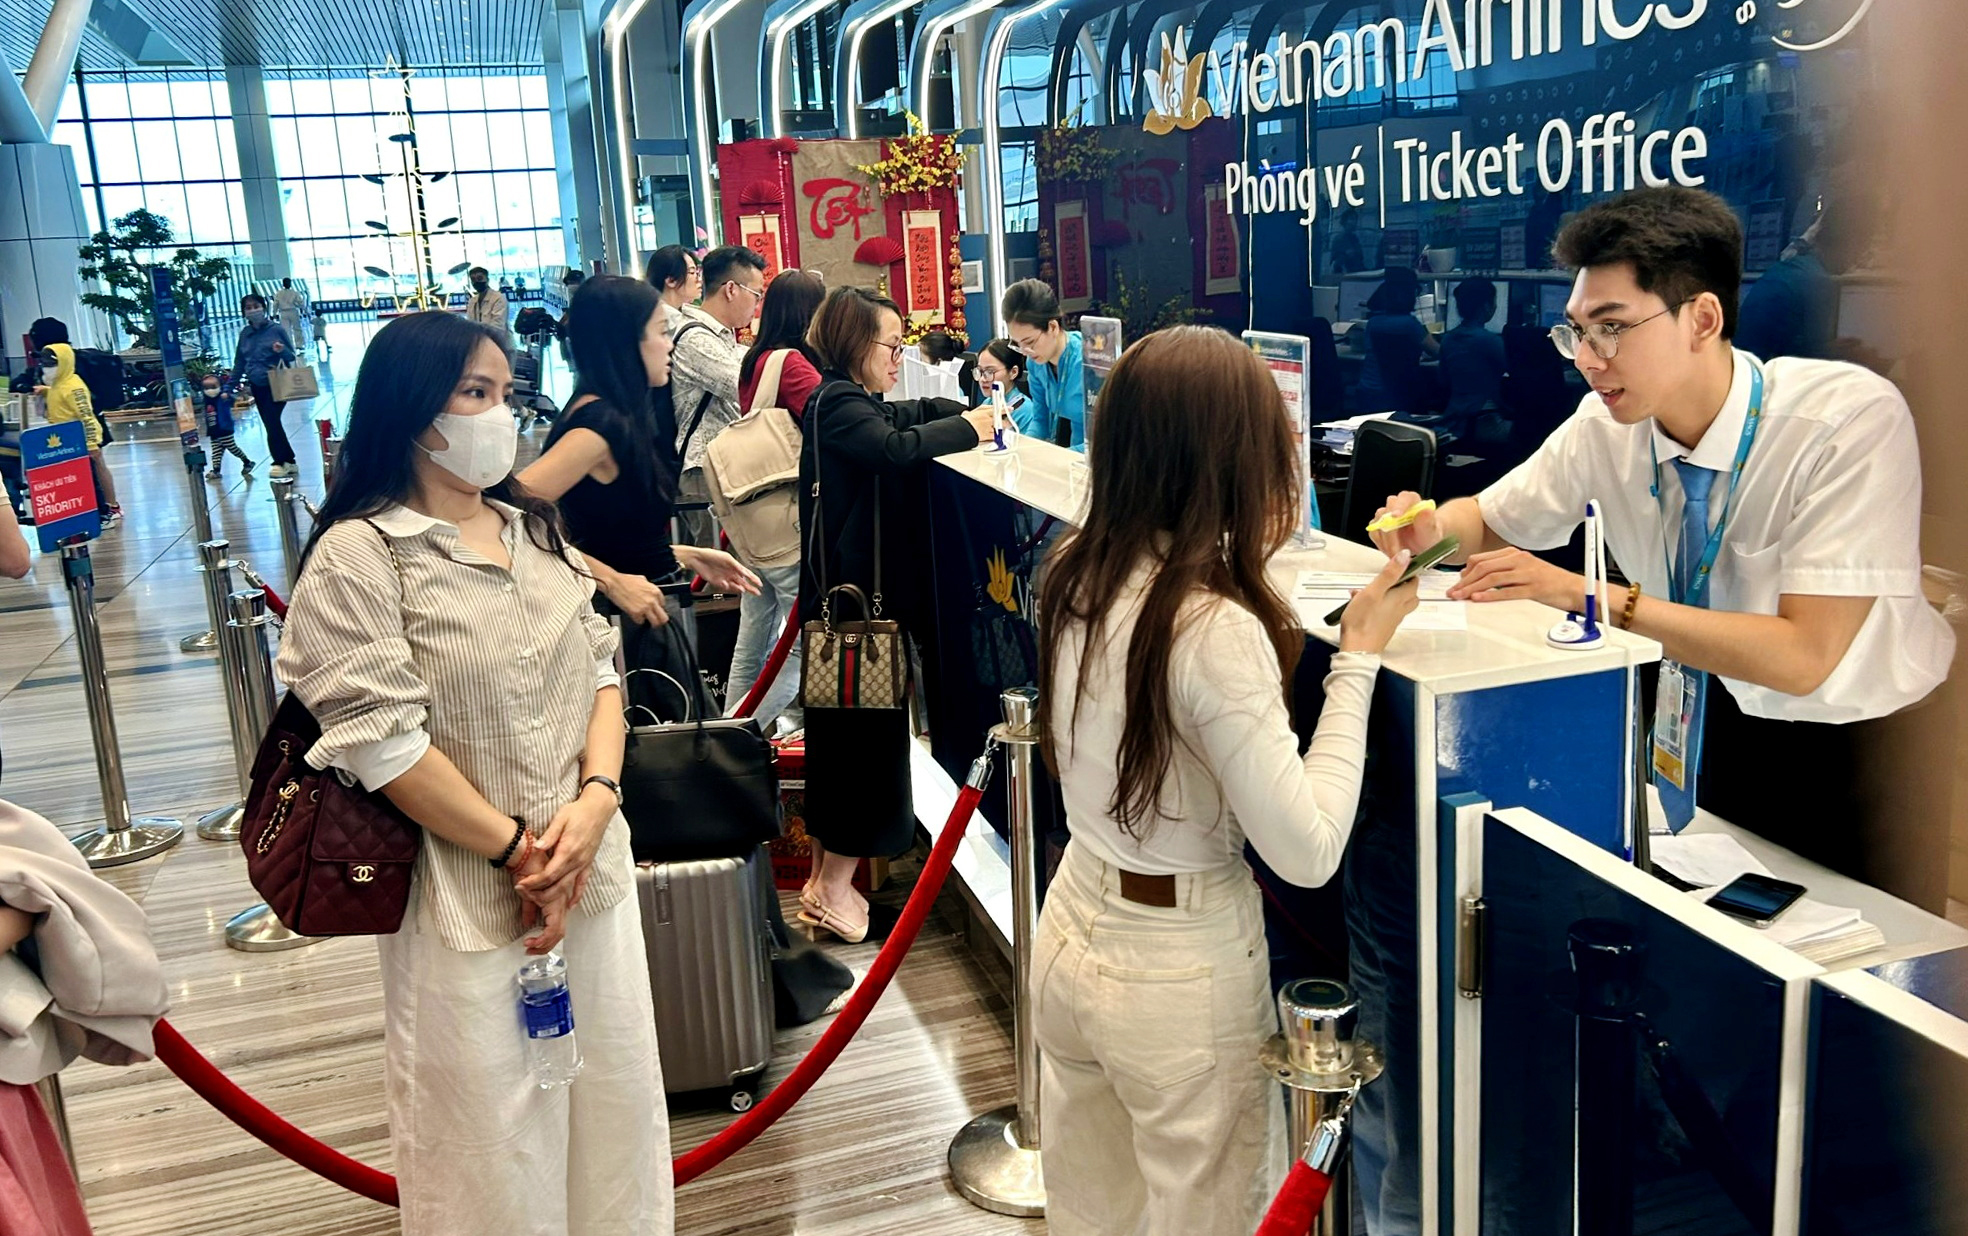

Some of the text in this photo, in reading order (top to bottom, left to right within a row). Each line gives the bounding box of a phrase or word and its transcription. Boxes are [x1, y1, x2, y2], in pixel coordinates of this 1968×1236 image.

[1208, 18, 1407, 120] Vietnam
[1225, 111, 1708, 226] Phòng vé Ticket Office
[35, 491, 56, 506] SKY
[37, 496, 84, 518] PRIORITY
